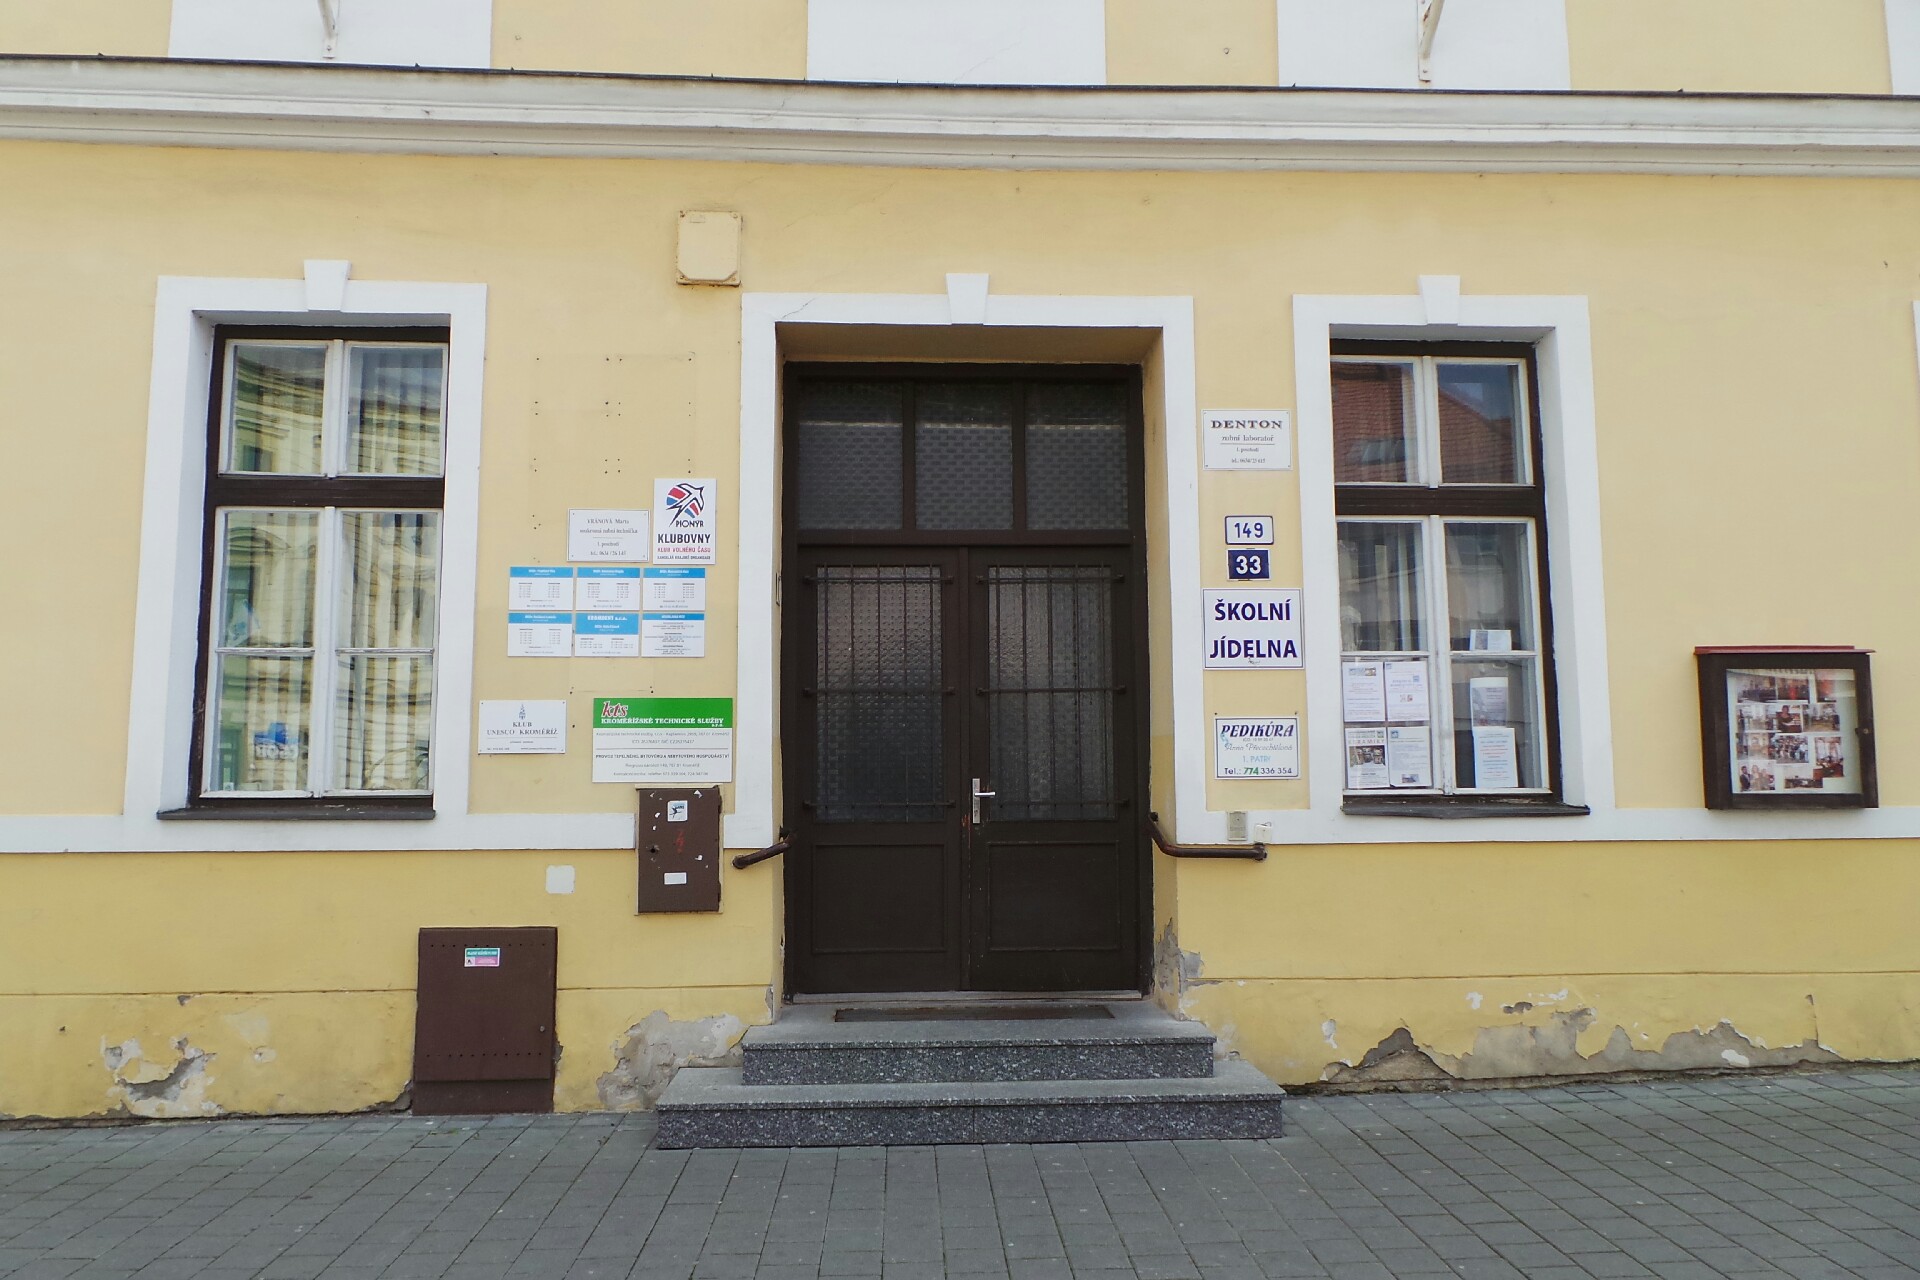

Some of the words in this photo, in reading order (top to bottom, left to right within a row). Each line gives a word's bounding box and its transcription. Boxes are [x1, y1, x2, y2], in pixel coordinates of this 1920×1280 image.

[1210, 419, 1283, 430] DENTON
[1221, 434, 1240, 442] zubní
[1243, 434, 1274, 442] laboratoř
[1234, 522, 1264, 539] 149
[657, 533, 711, 544] KLUBOVNY
[672, 545, 696, 553] VOLNÉHO
[697, 545, 711, 553] ČASU
[1235, 555, 1262, 575] 33
[1214, 598, 1292, 621] ŠKOLNÍ
[1209, 635, 1298, 659] JÍDELNA
[600, 700, 629, 718] kts
[601, 716, 654, 724] KROMĚŘÍŽSKÉ
[655, 716, 696, 724] TECHNICKÉ
[697, 716, 724, 724] SLUŽBY
[519, 727, 559, 736] KROMĚŘÍŽ
[1220, 721, 1295, 738] PEDIKÚRA
[1224, 767, 1241, 775] Tel.:
[1243, 767, 1259, 775] 774
[1260, 767, 1275, 775] 336
[1277, 767, 1292, 775] 354
